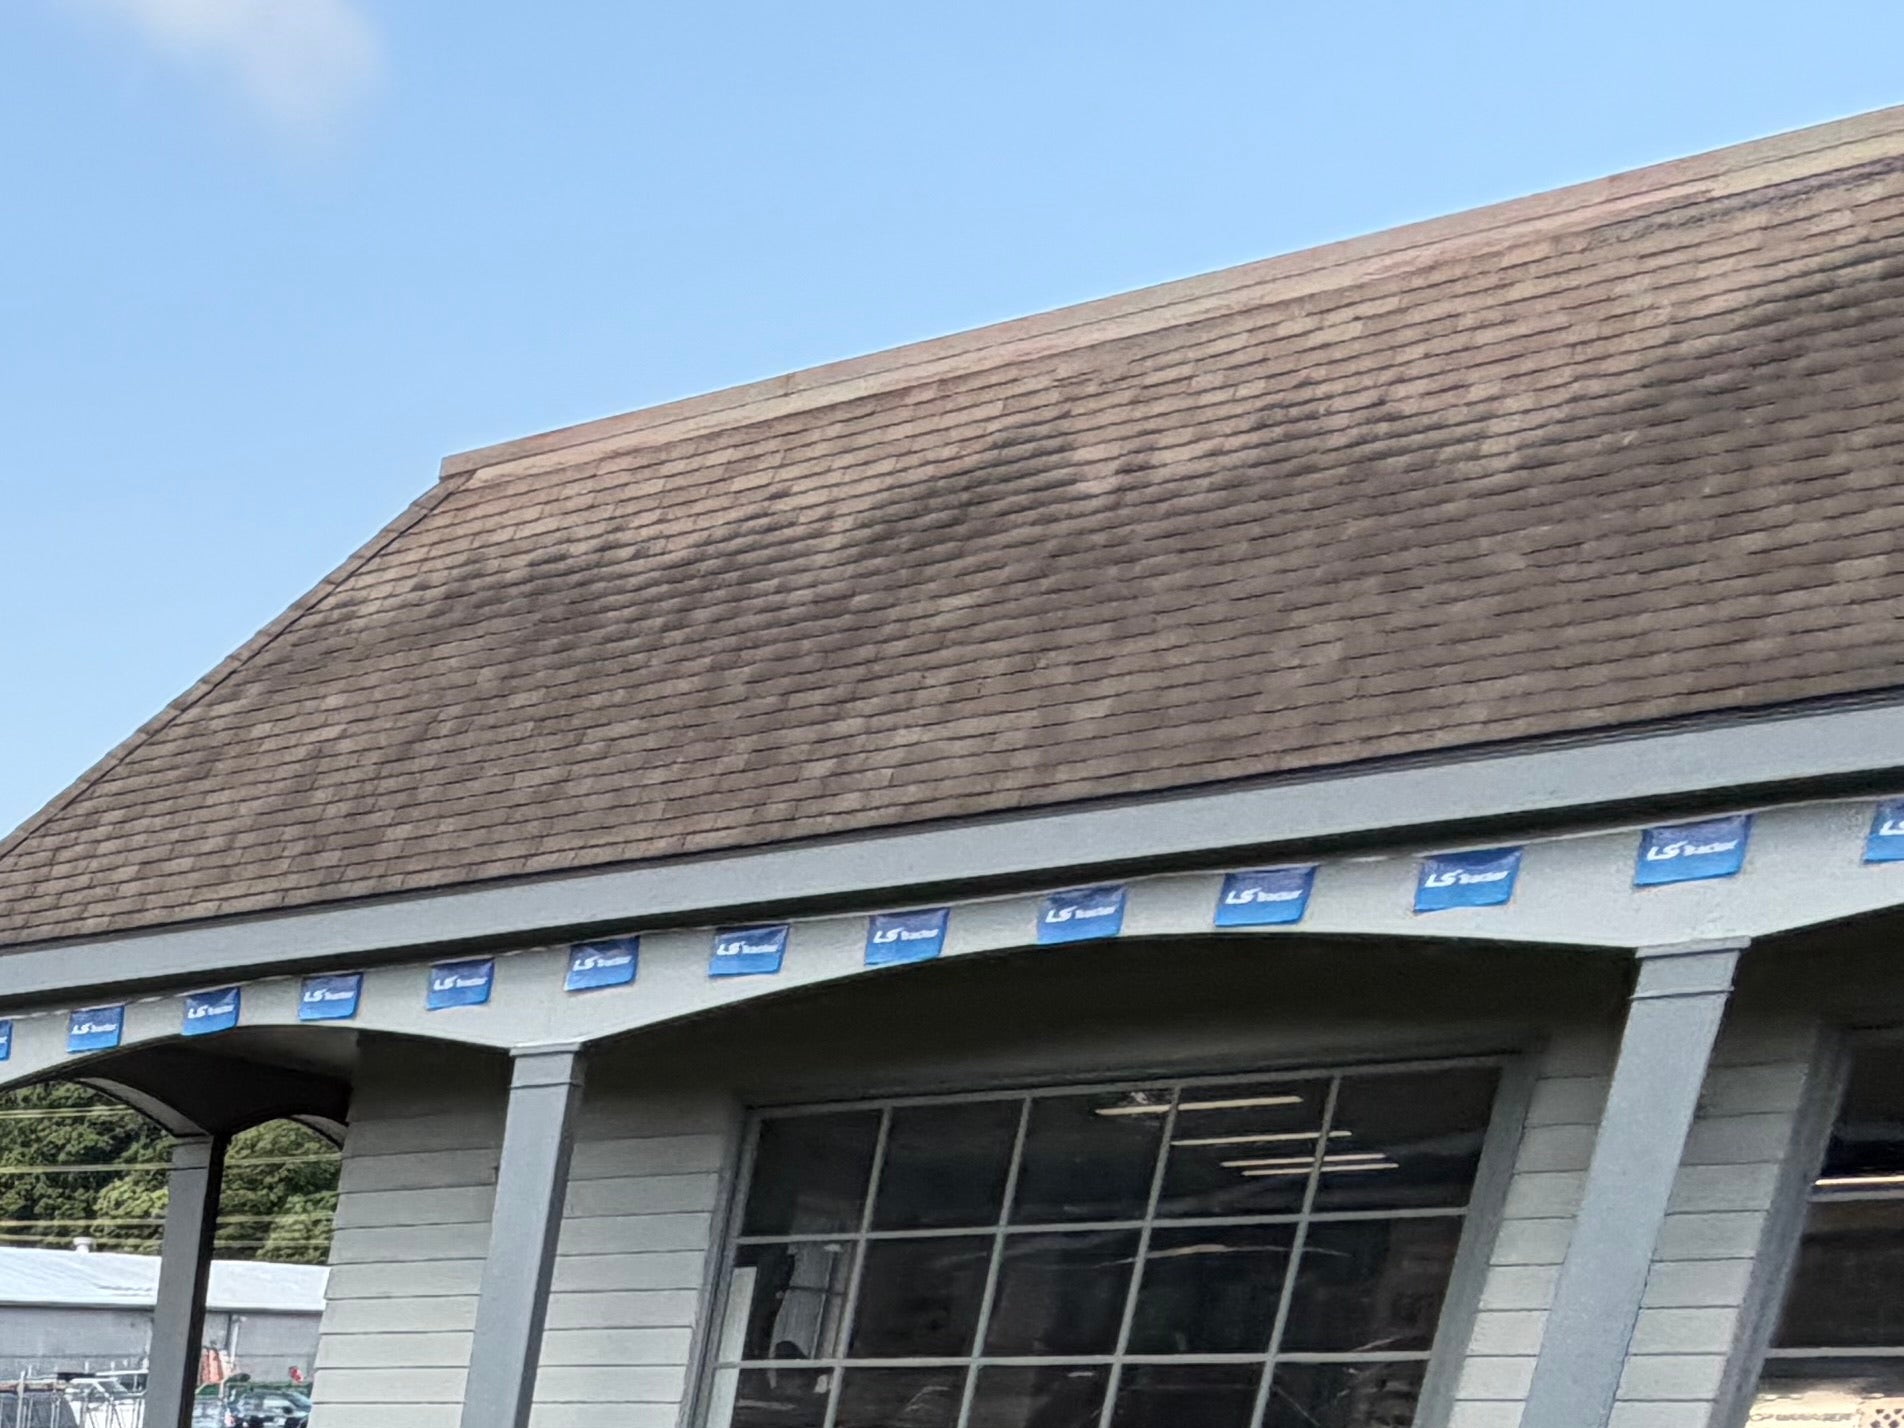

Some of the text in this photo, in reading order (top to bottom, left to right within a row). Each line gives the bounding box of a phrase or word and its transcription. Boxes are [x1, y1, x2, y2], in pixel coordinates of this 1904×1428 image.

[1647, 840, 1737, 860] LS Tractor
[1425, 870, 1508, 887] LS Tractor
[1226, 888, 1260, 904] LS
[1046, 906, 1075, 922] LS
[874, 928, 902, 943] LS
[717, 942, 744, 955] LS
